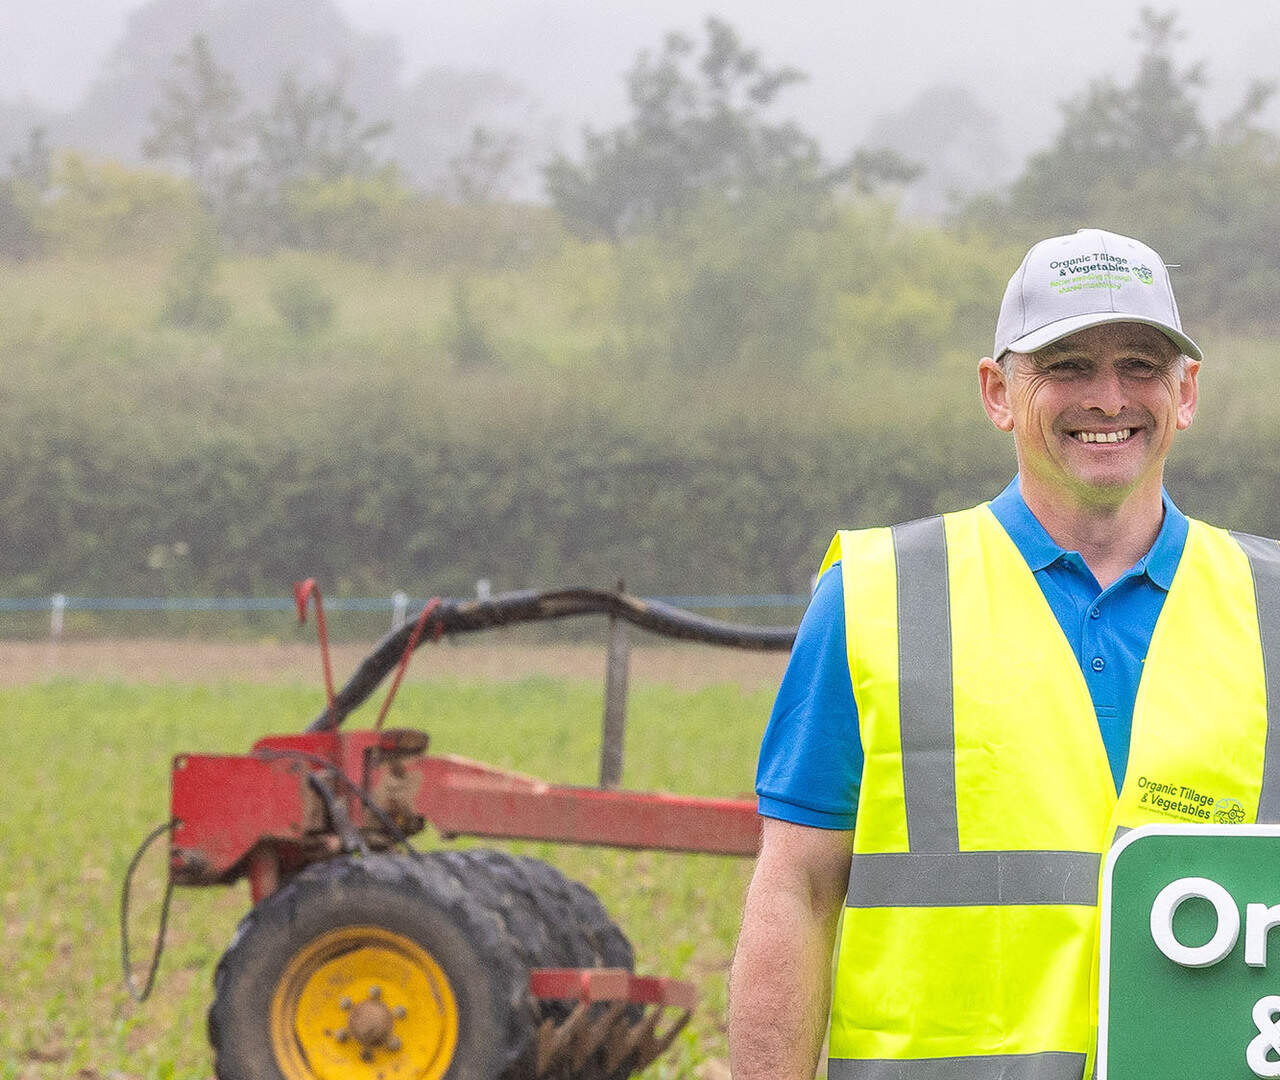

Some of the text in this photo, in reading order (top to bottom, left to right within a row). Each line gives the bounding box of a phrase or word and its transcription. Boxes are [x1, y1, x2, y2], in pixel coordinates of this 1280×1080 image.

[1050, 253, 1128, 269] Organic Tillage
[1068, 263, 1130, 275] Vegetables
[1138, 776, 1214, 807] Organic Tillage
[1141, 793, 1148, 803] &
[1151, 793, 1211, 820] Vegetables
